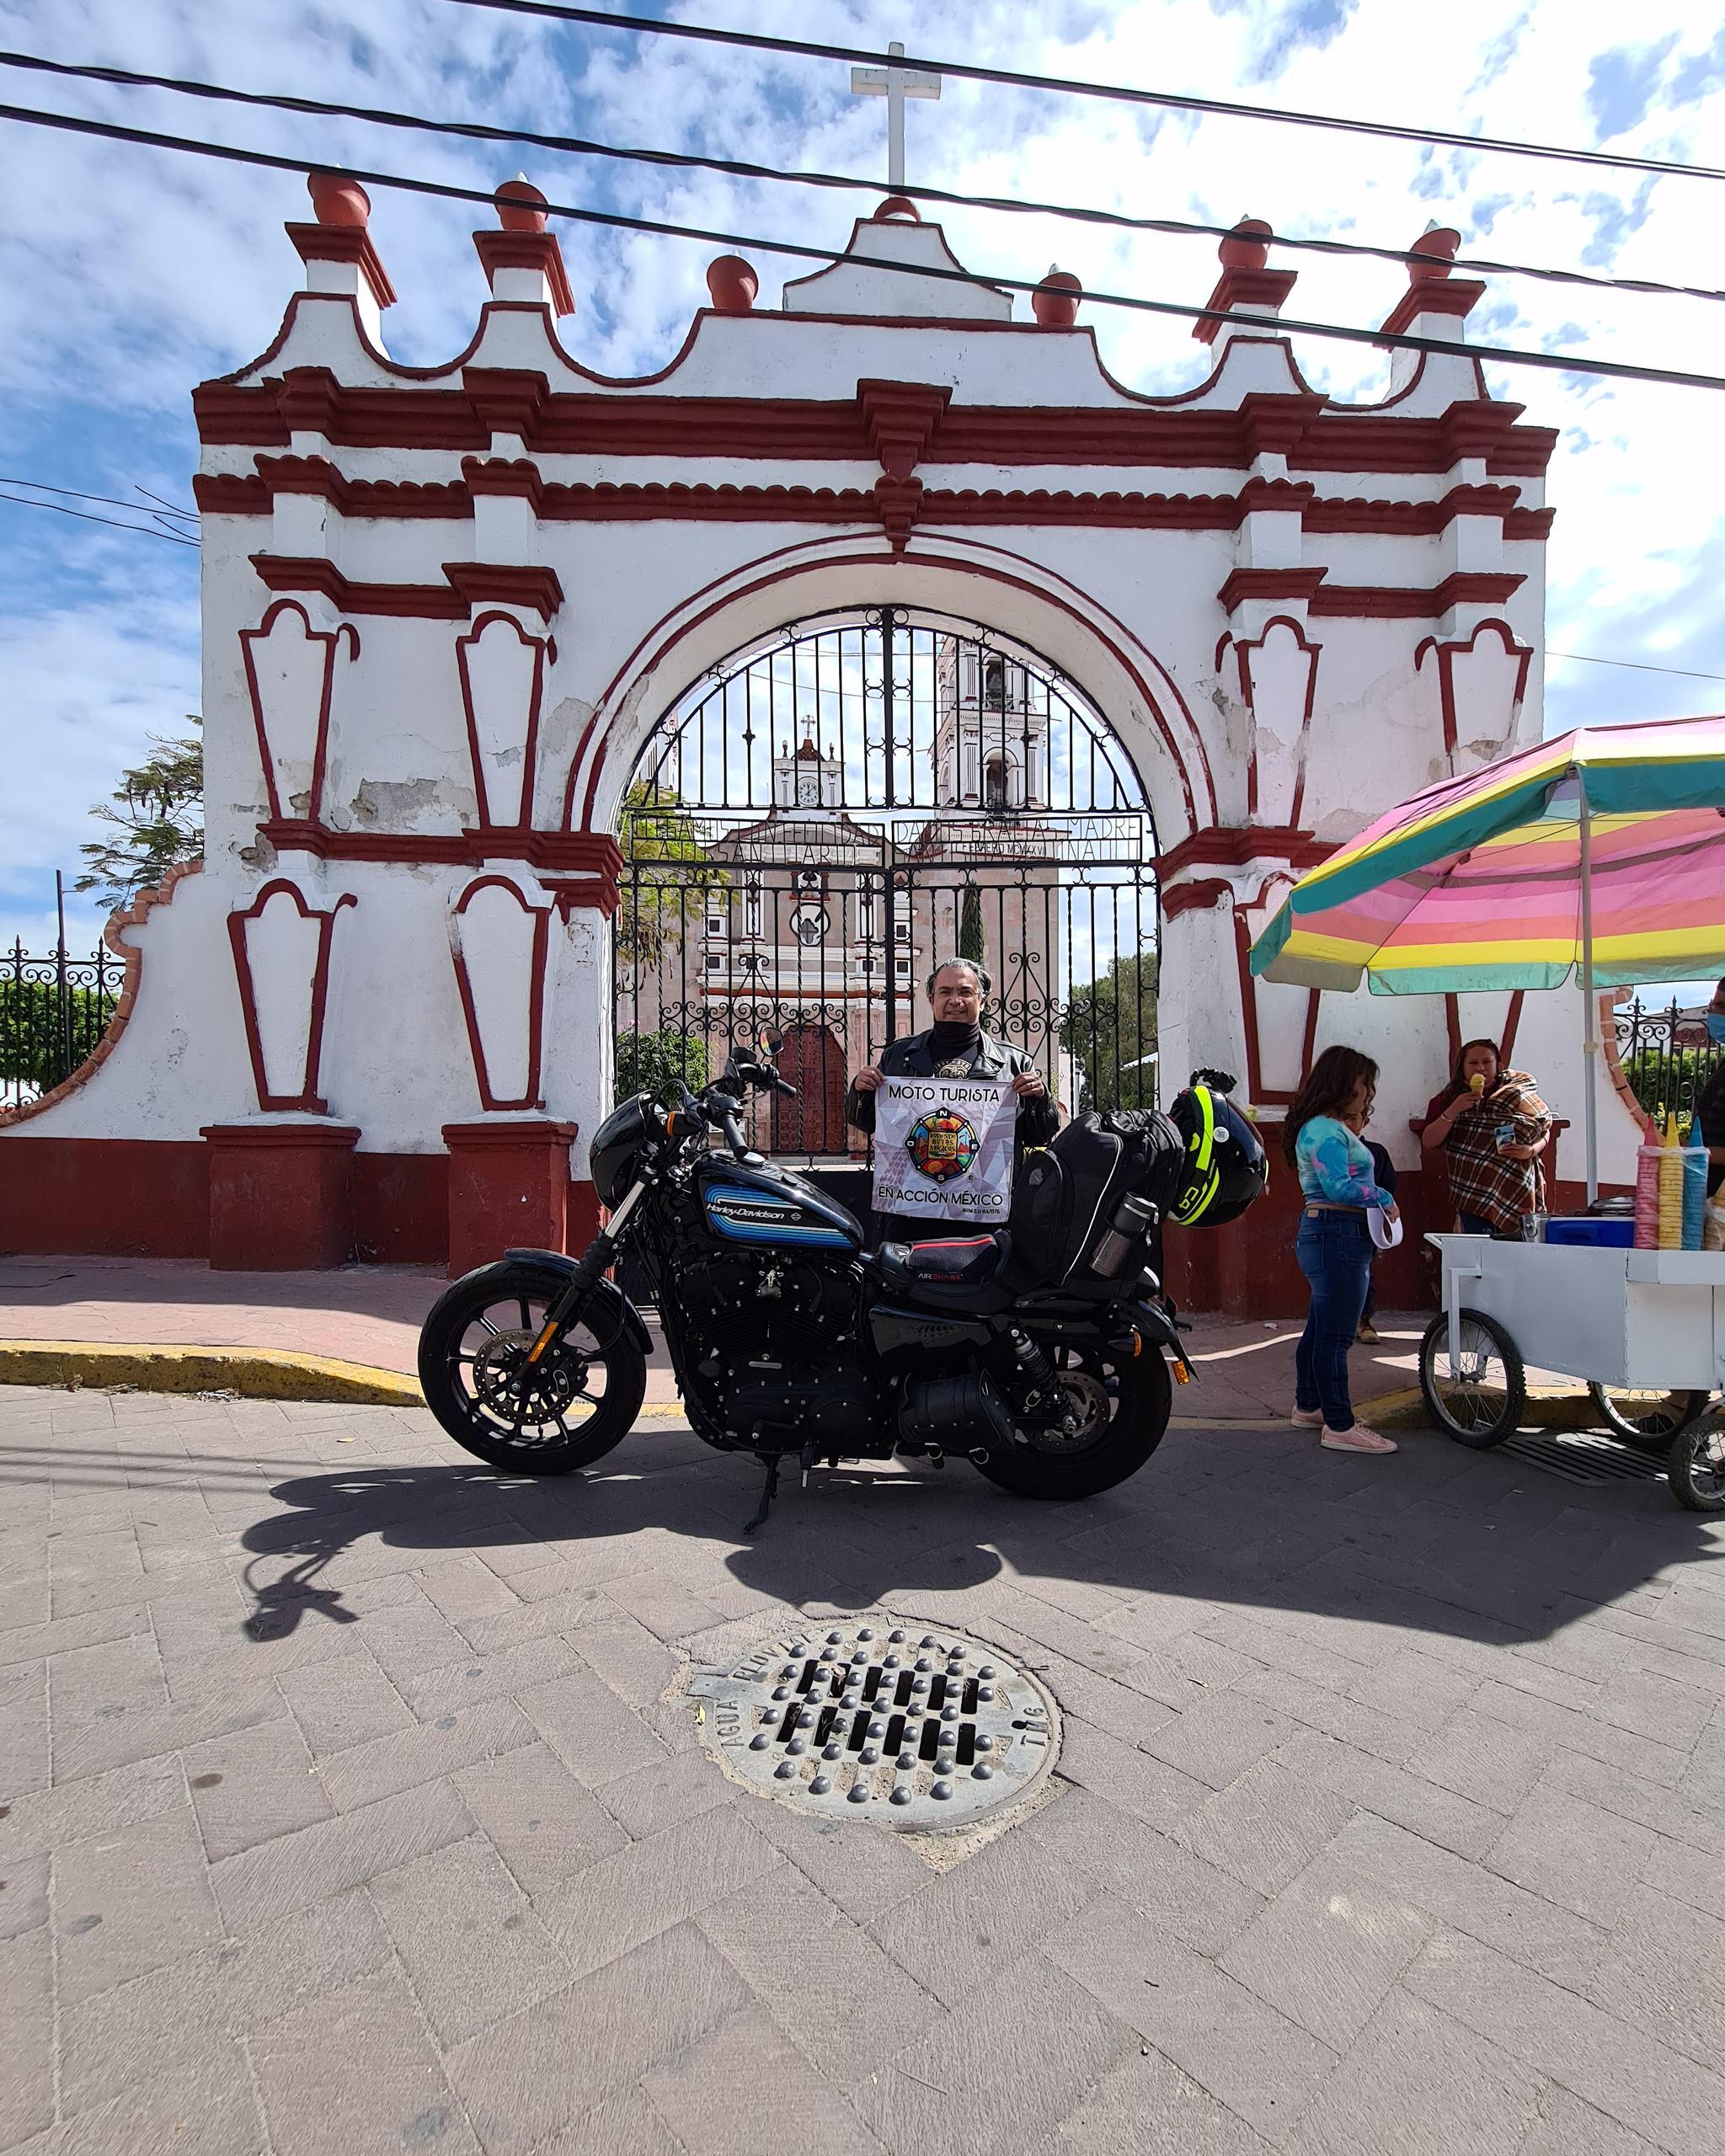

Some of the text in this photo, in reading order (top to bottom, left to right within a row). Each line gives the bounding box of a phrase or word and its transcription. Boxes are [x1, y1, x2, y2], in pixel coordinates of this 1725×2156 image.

[889, 1085, 1000, 1102] MOTO TURISTA
[879, 1186, 1003, 1206] EN ACCIÓN MÉXICO
[706, 1203, 785, 1220] Harley-Davidson
[716, 1700, 745, 1747] AGUA
